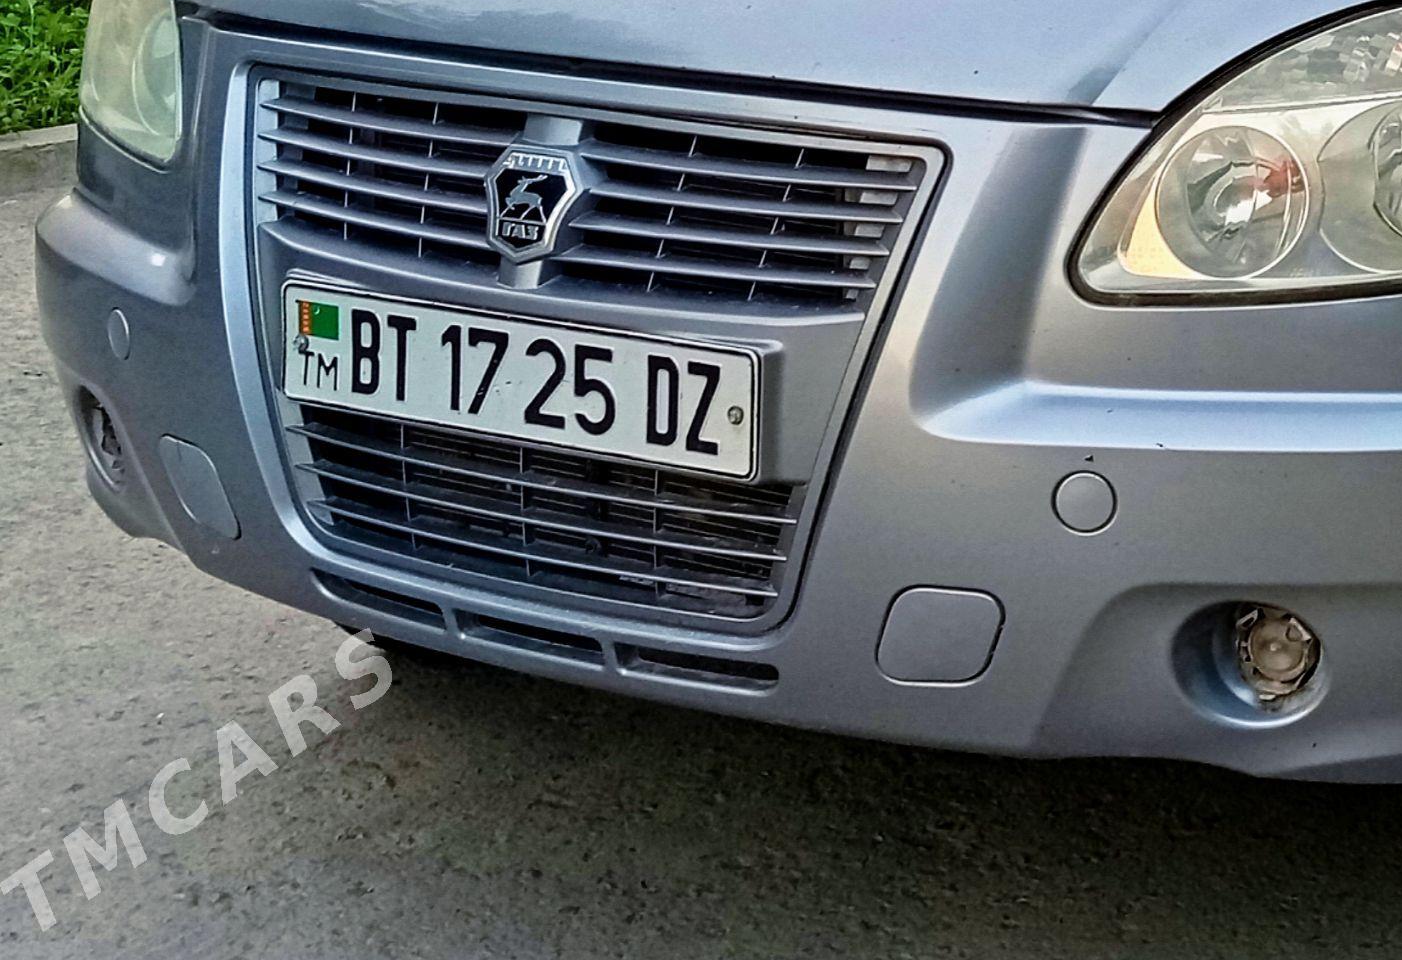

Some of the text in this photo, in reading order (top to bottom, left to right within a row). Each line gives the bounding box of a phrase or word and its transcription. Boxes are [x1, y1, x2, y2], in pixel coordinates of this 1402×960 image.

[301, 348, 339, 392] TM
[350, 308, 417, 402] BT
[645, 354, 721, 456] DZ
